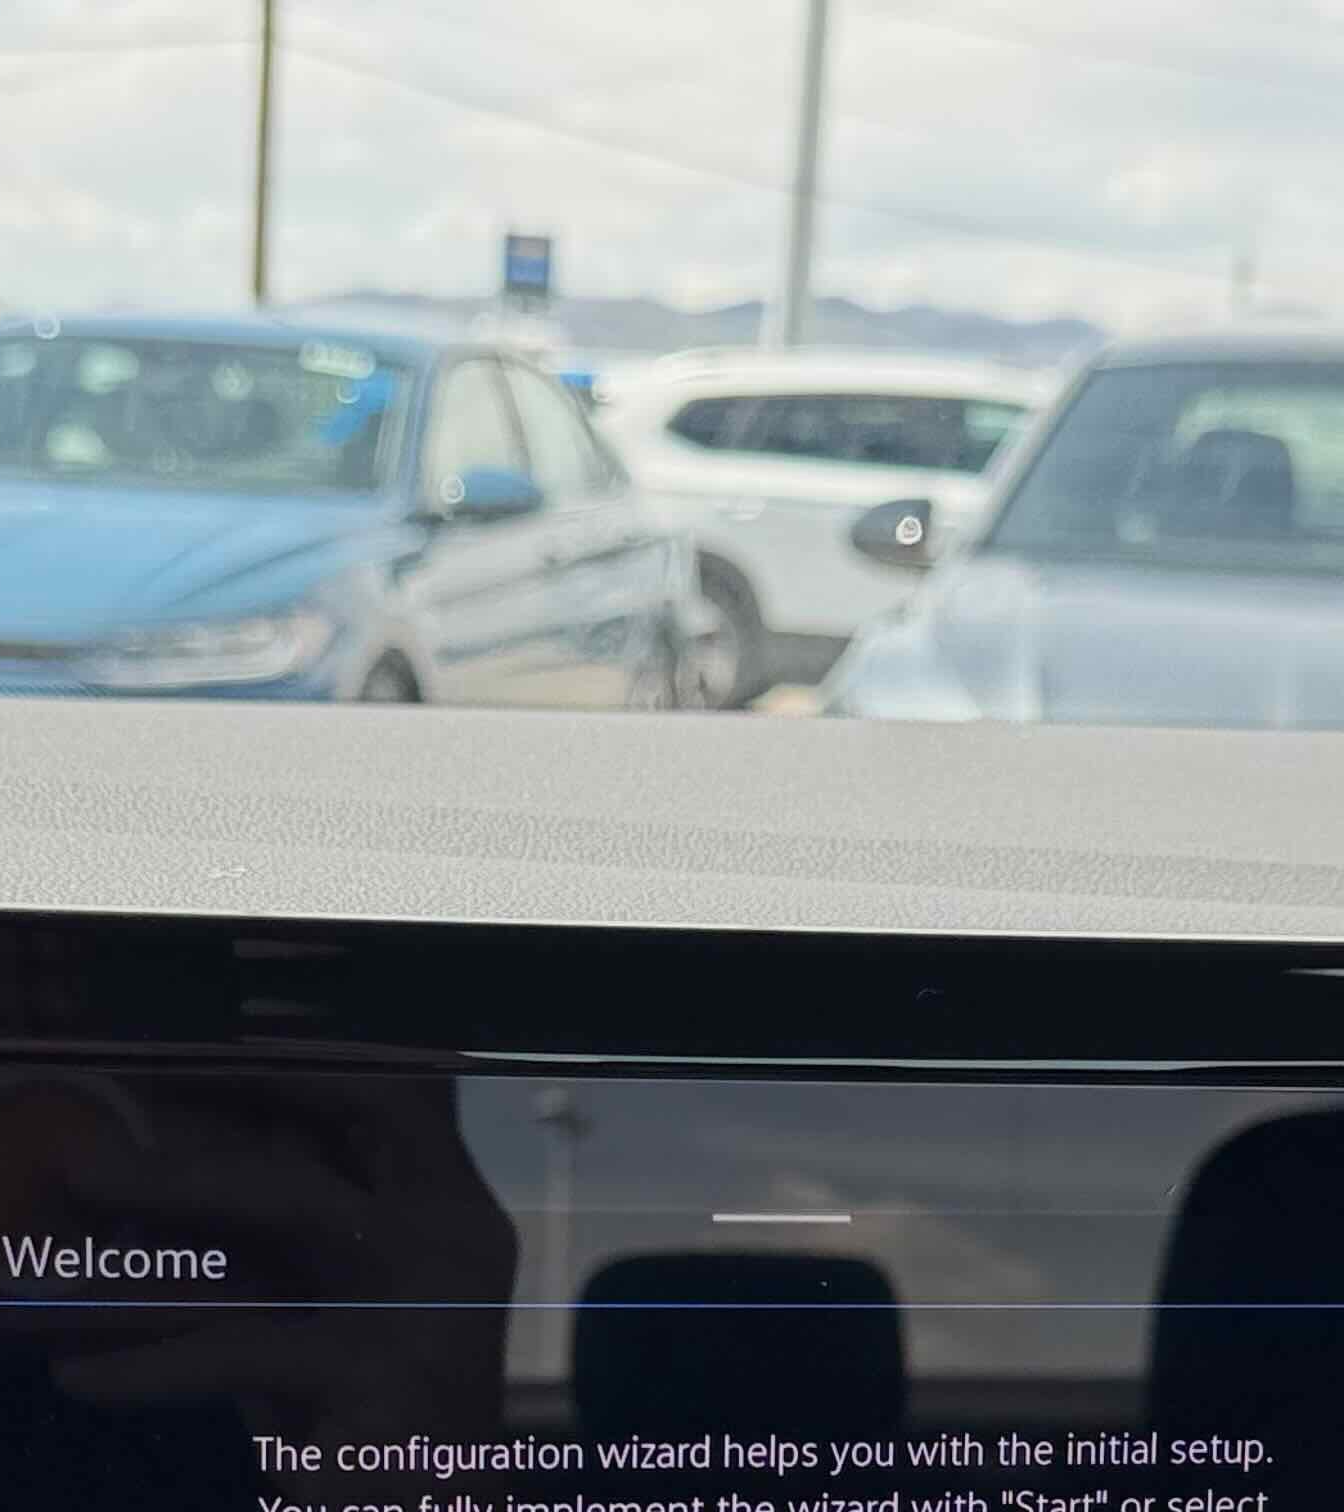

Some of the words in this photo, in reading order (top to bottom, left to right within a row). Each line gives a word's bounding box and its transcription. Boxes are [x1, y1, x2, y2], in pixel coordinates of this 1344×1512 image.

[4, 1238, 227, 1279] Welcome
[254, 1438, 322, 1471] The
[339, 1437, 583, 1480] configuration
[599, 1436, 711, 1469] wizard
[726, 1436, 818, 1476] helps
[832, 1444, 894, 1476] you
[909, 1434, 984, 1466] with
[999, 1434, 1054, 1466] the
[1069, 1433, 1158, 1465] initial
[1173, 1437, 1273, 1473] setup.
